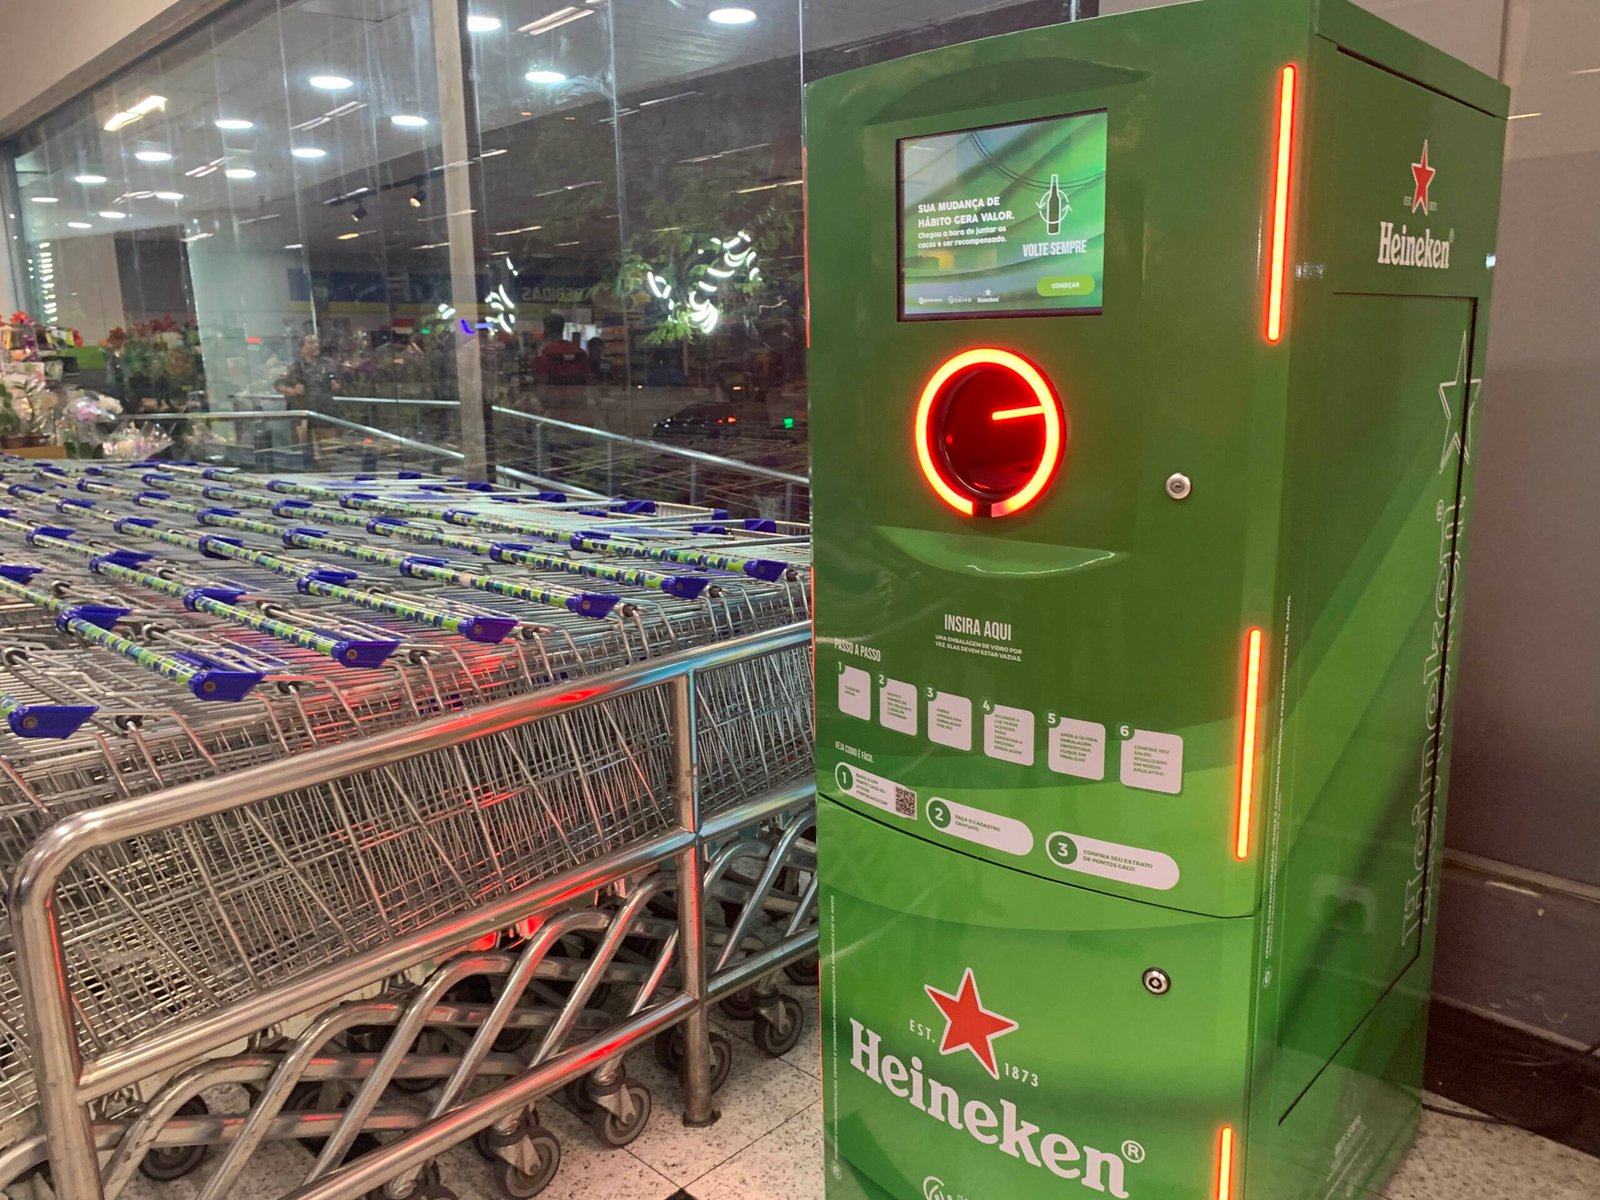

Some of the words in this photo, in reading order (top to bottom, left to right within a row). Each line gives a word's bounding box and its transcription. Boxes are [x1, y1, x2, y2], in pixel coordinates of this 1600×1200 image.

[918, 203, 936, 213] SUA
[938, 198, 985, 212] MUDANÇA
[986, 197, 1000, 206] DE
[918, 216, 951, 228] HÁBITO
[954, 214, 978, 225] GERA
[981, 211, 1015, 222] VALOR.
[918, 231, 942, 241] Chegou
[948, 228, 965, 237] hora
[976, 226, 997, 235] juntar
[1023, 243, 1048, 257] VOLTE
[1050, 240, 1087, 255] SEMPRE
[1051, 282, 1080, 290] COMEÇAR
[944, 614, 980, 636] INSIRA
[984, 621, 1011, 641] AQUI
[834, 638, 854, 654] PASSO
[855, 644, 859, 654] A
[860, 645, 881, 662] PASSO
[947, 643, 960, 651] ELAS
[961, 646, 980, 655] DEVEM
[981, 649, 998, 658] ESTAR
[948, 636, 981, 648] EMBALAGEM
[990, 644, 1008, 652] VIDRO
[1010, 646, 1022, 655] POR
[838, 662, 842, 671] 1
[878, 674, 885, 684] 2
[927, 687, 933, 698] 3
[982, 700, 990, 711] 4
[1048, 713, 1056, 724] 5
[1120, 725, 1130, 736] 6
[842, 772, 846, 784] 1
[935, 808, 944, 821] 2
[1057, 842, 1069, 857] 3
[1083, 850, 1110, 860] CONFIRA
[1124, 858, 1152, 868] EXTRATO
[1092, 857, 1117, 868] PONTOS
[909, 1018, 936, 1043] EST.
[1003, 1063, 1039, 1087] 1873
